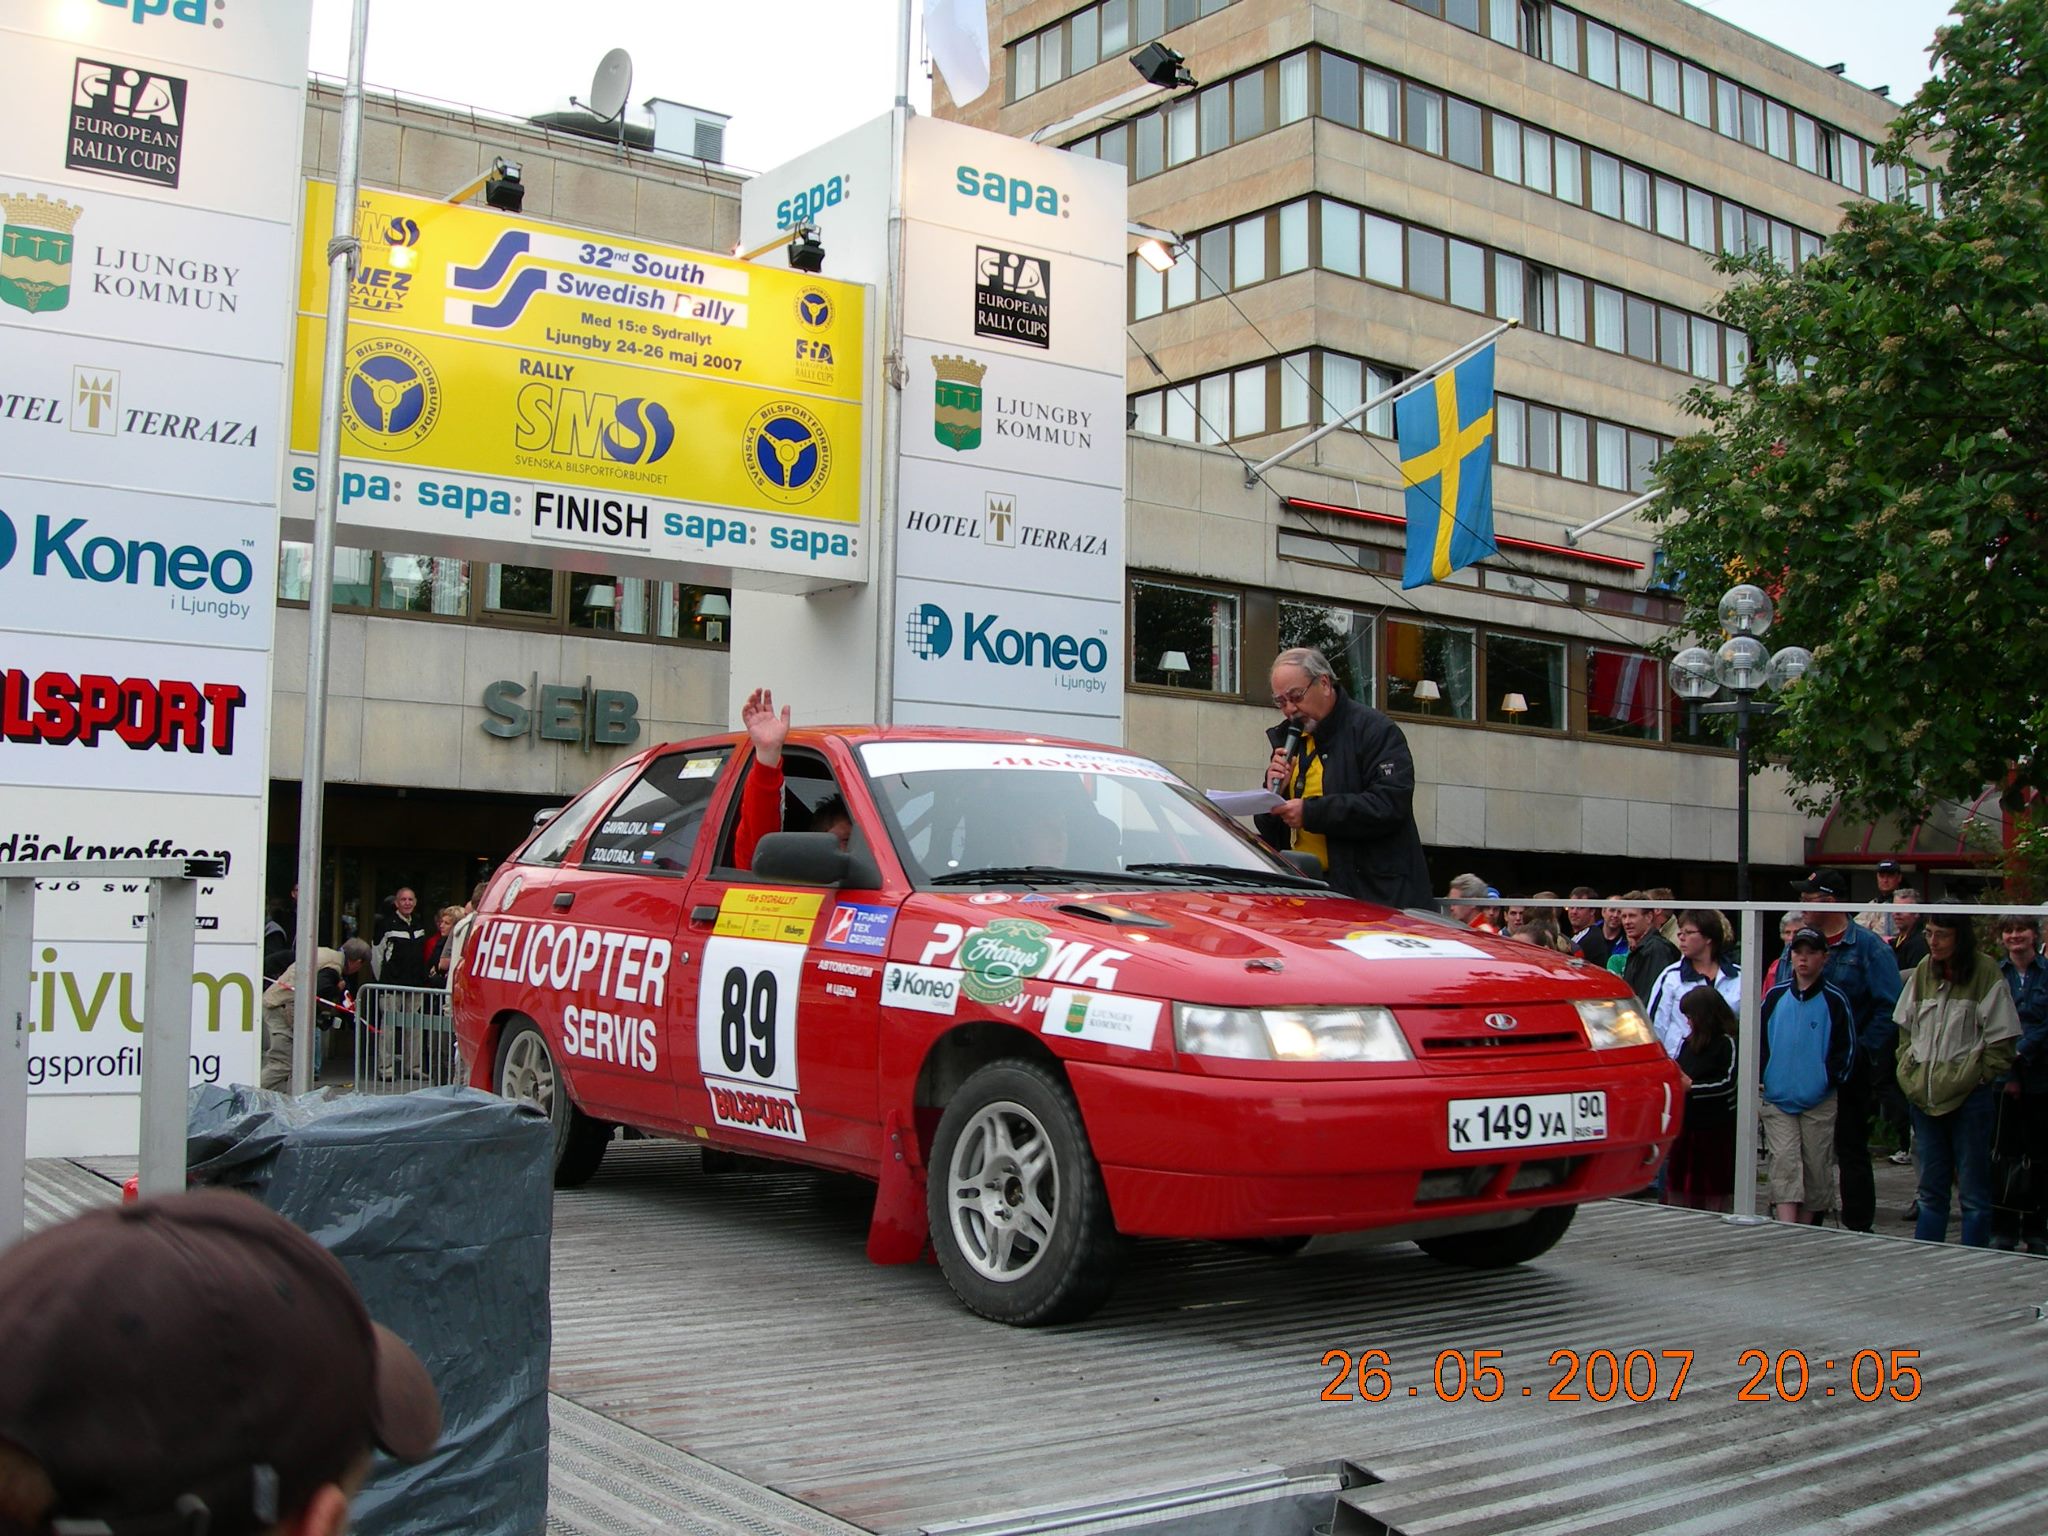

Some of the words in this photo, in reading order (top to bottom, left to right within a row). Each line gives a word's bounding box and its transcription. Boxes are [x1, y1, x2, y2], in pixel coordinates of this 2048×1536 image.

[74, 115, 180, 149] EUROPEAN
[72, 138, 128, 164] RALLY
[130, 149, 176, 175] CUPS
[956, 165, 1070, 218] sapa:
[96, 246, 241, 288] LJUNGBY
[632, 253, 705, 285] South
[93, 273, 239, 314] KOMMUN
[557, 272, 666, 310] Swedish
[979, 291, 1048, 317] EUROPEAN
[581, 312, 612, 328] Med
[617, 319, 647, 334] 15:e
[652, 323, 712, 346] Sydrallyt
[978, 309, 1016, 331] RALLY
[1016, 318, 1048, 339] CUPS
[545, 328, 611, 353] Ljungby
[616, 339, 664, 358] 24-26
[669, 350, 698, 367] maj
[703, 355, 743, 372] 2007
[519, 358, 575, 381] RALLY
[0, 394, 64, 424] TEL
[123, 408, 259, 447] TERRAZA
[997, 396, 1092, 427] LJUNGBY
[996, 418, 1092, 449] KOMMUN
[514, 455, 563, 471] SVENSKA
[745, 426, 765, 488] SVENSKA
[292, 466, 402, 505] spa:
[418, 481, 521, 519] sapa:
[535, 491, 648, 540] FINISH
[664, 512, 756, 548] sapa:
[770, 526, 857, 560] sapa:
[905, 511, 981, 538] HOTEL
[1020, 526, 1109, 557] TERRAZA
[33, 514, 253, 594] Koneo
[181, 595, 250, 620] Ljungby
[964, 612, 1108, 673] Koneo
[1061, 675, 1107, 694] Ljungby
[0, 668, 246, 756] LSPORT
[481, 678, 642, 745] SEB
[853, 922, 872, 933] ТЕХ
[856, 911, 889, 924] ТРАНС
[849, 933, 886, 947] СЕРВИС
[471, 920, 673, 1008] HELICOPTER
[902, 970, 955, 999] Koneo
[563, 1004, 657, 1072] SERVIS
[720, 966, 778, 1079] 89
[710, 1085, 799, 1135] BILSPORT
[1477, 1103, 1532, 1142] 149
[1578, 1095, 1603, 1119] 90
[1575, 1126, 1592, 1137] RUS
